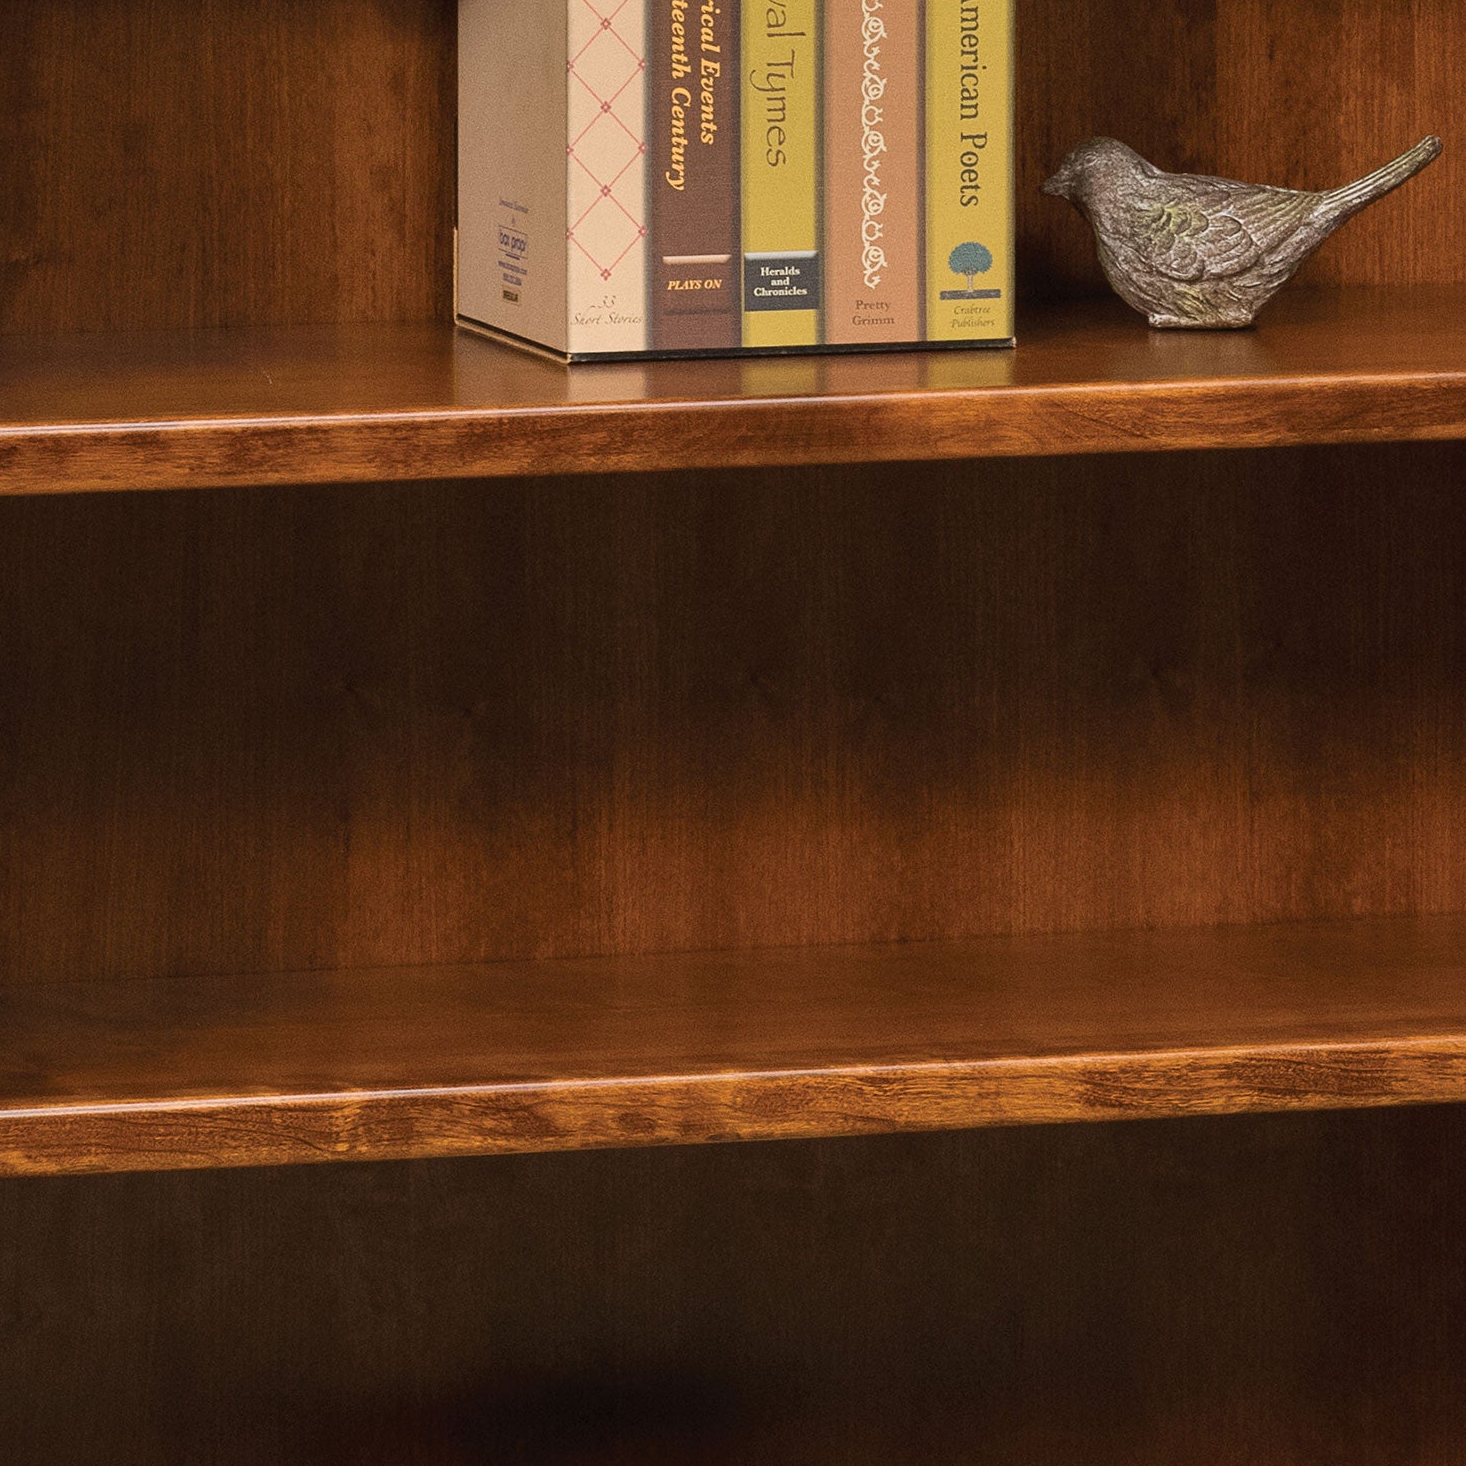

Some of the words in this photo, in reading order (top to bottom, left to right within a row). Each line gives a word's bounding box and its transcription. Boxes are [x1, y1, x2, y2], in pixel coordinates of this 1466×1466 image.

[700, 59, 722, 146] Events
[749, 49, 796, 167] Tymes
[666, 87, 692, 191] Century
[959, 132, 989, 208] Poets
[760, 266, 801, 277] Heralds
[667, 280, 702, 291] PLAYS
[704, 279, 722, 290] ON
[771, 277, 790, 287] and
[753, 287, 808, 297] Chronicles
[855, 300, 891, 312] Pretty
[953, 305, 991, 315] Crabtree
[570, 312, 602, 325] Short
[604, 311, 643, 325] Stories
[852, 315, 895, 326] Grimm
[951, 318, 995, 329] Publishers
